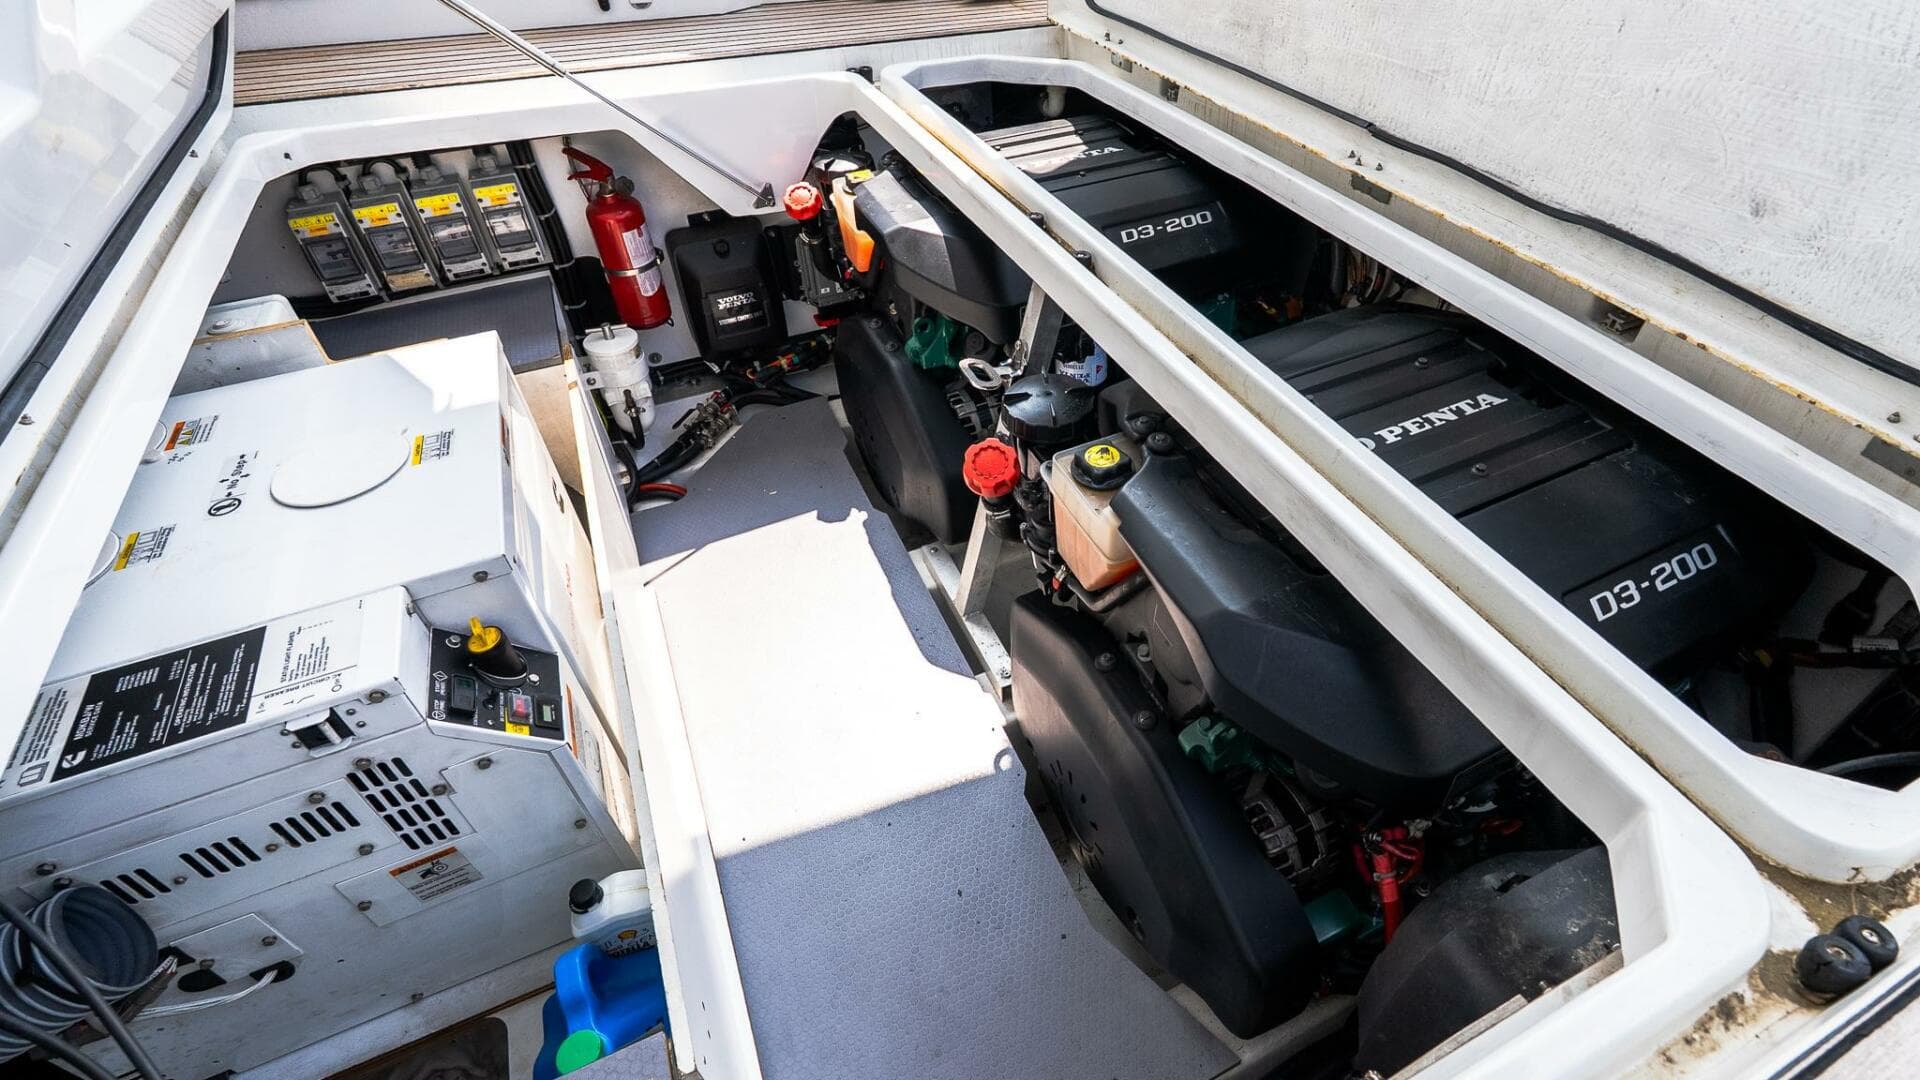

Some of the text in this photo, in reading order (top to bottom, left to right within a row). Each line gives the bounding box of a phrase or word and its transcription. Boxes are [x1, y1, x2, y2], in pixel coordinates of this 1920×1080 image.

[1120, 211, 1213, 244] D3-200
[717, 292, 754, 305] VOLVO
[718, 298, 758, 310] PENTA
[1374, 393, 1508, 444] PENTA
[226, 459, 248, 490] No Step
[1589, 543, 1718, 622] D3-200
